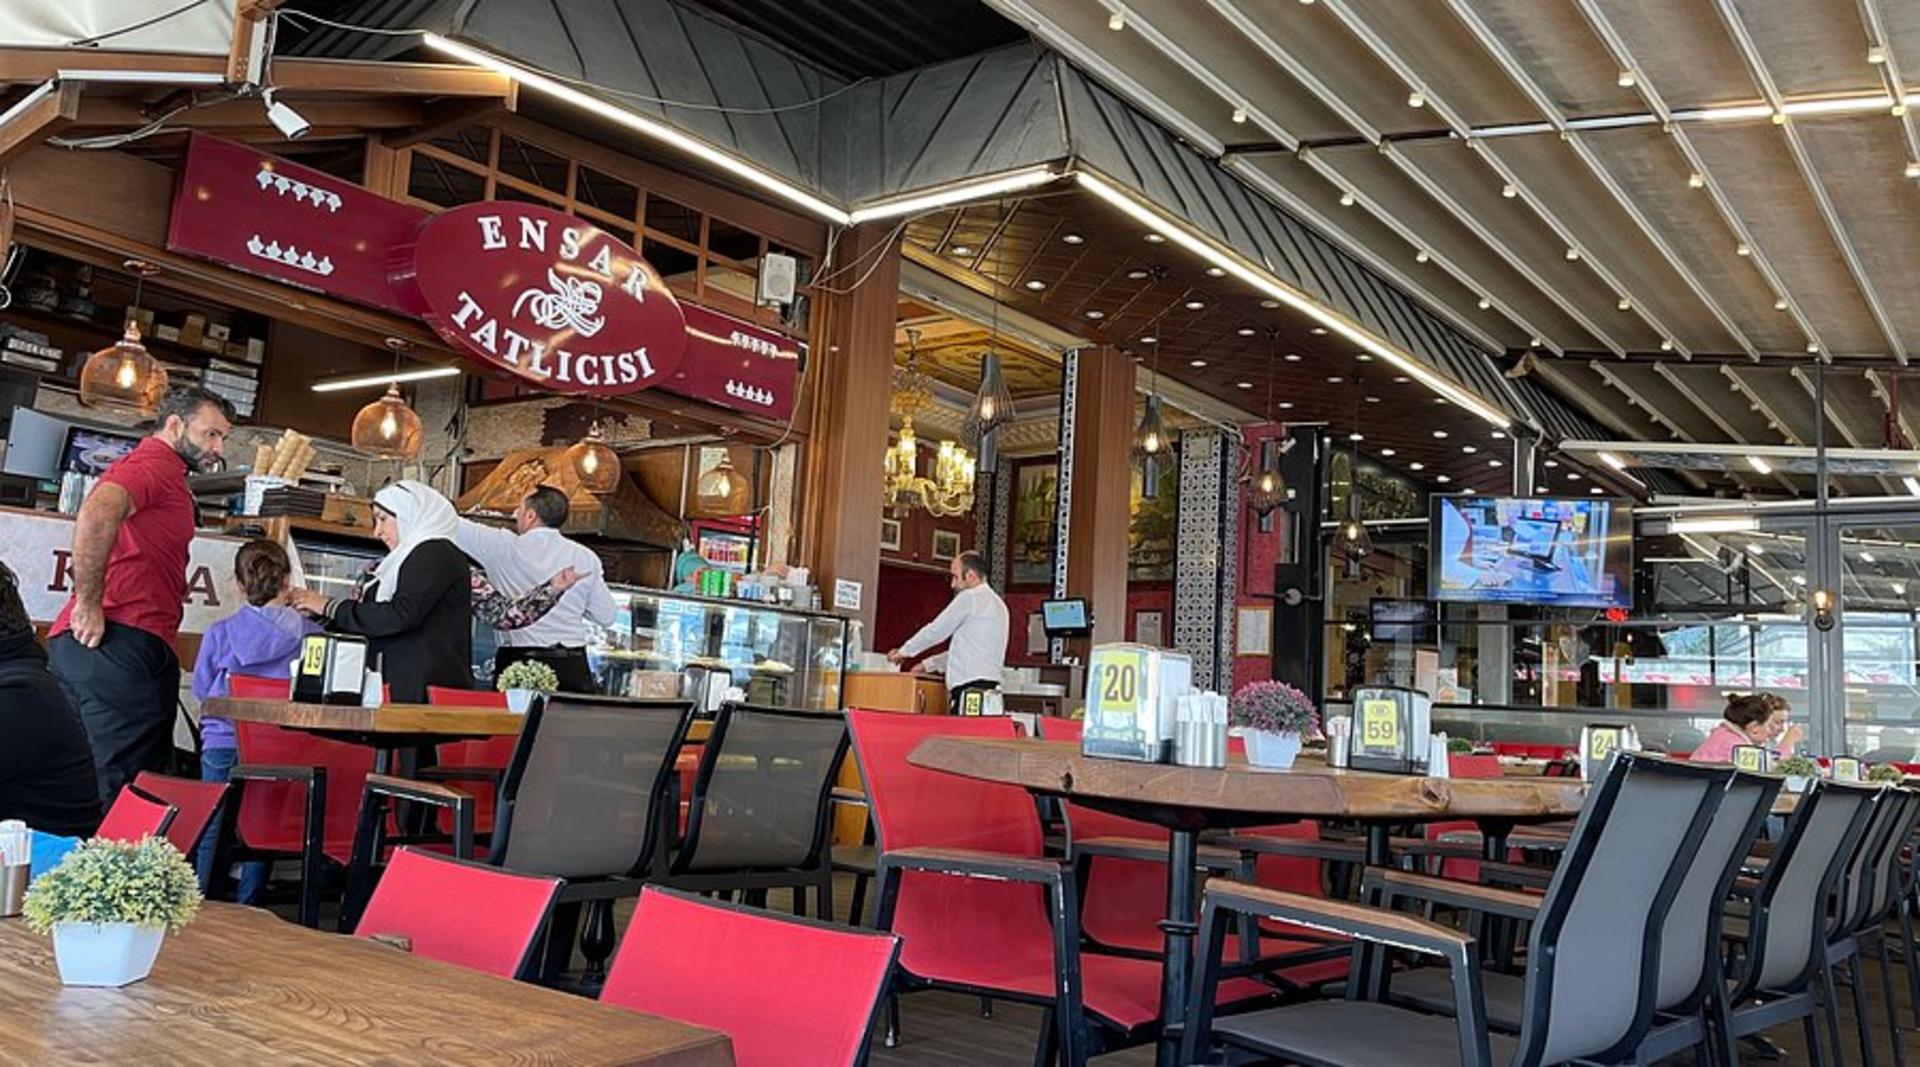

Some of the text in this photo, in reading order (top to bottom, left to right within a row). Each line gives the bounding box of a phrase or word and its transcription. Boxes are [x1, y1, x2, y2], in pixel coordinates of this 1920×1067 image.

[478, 215, 648, 303] ENSAR
[451, 291, 655, 385] TATLICISI
[306, 645, 323, 669] 19
[1104, 664, 1136, 703] 20
[1367, 720, 1394, 740] 59
[1595, 735, 1615, 755] 24
